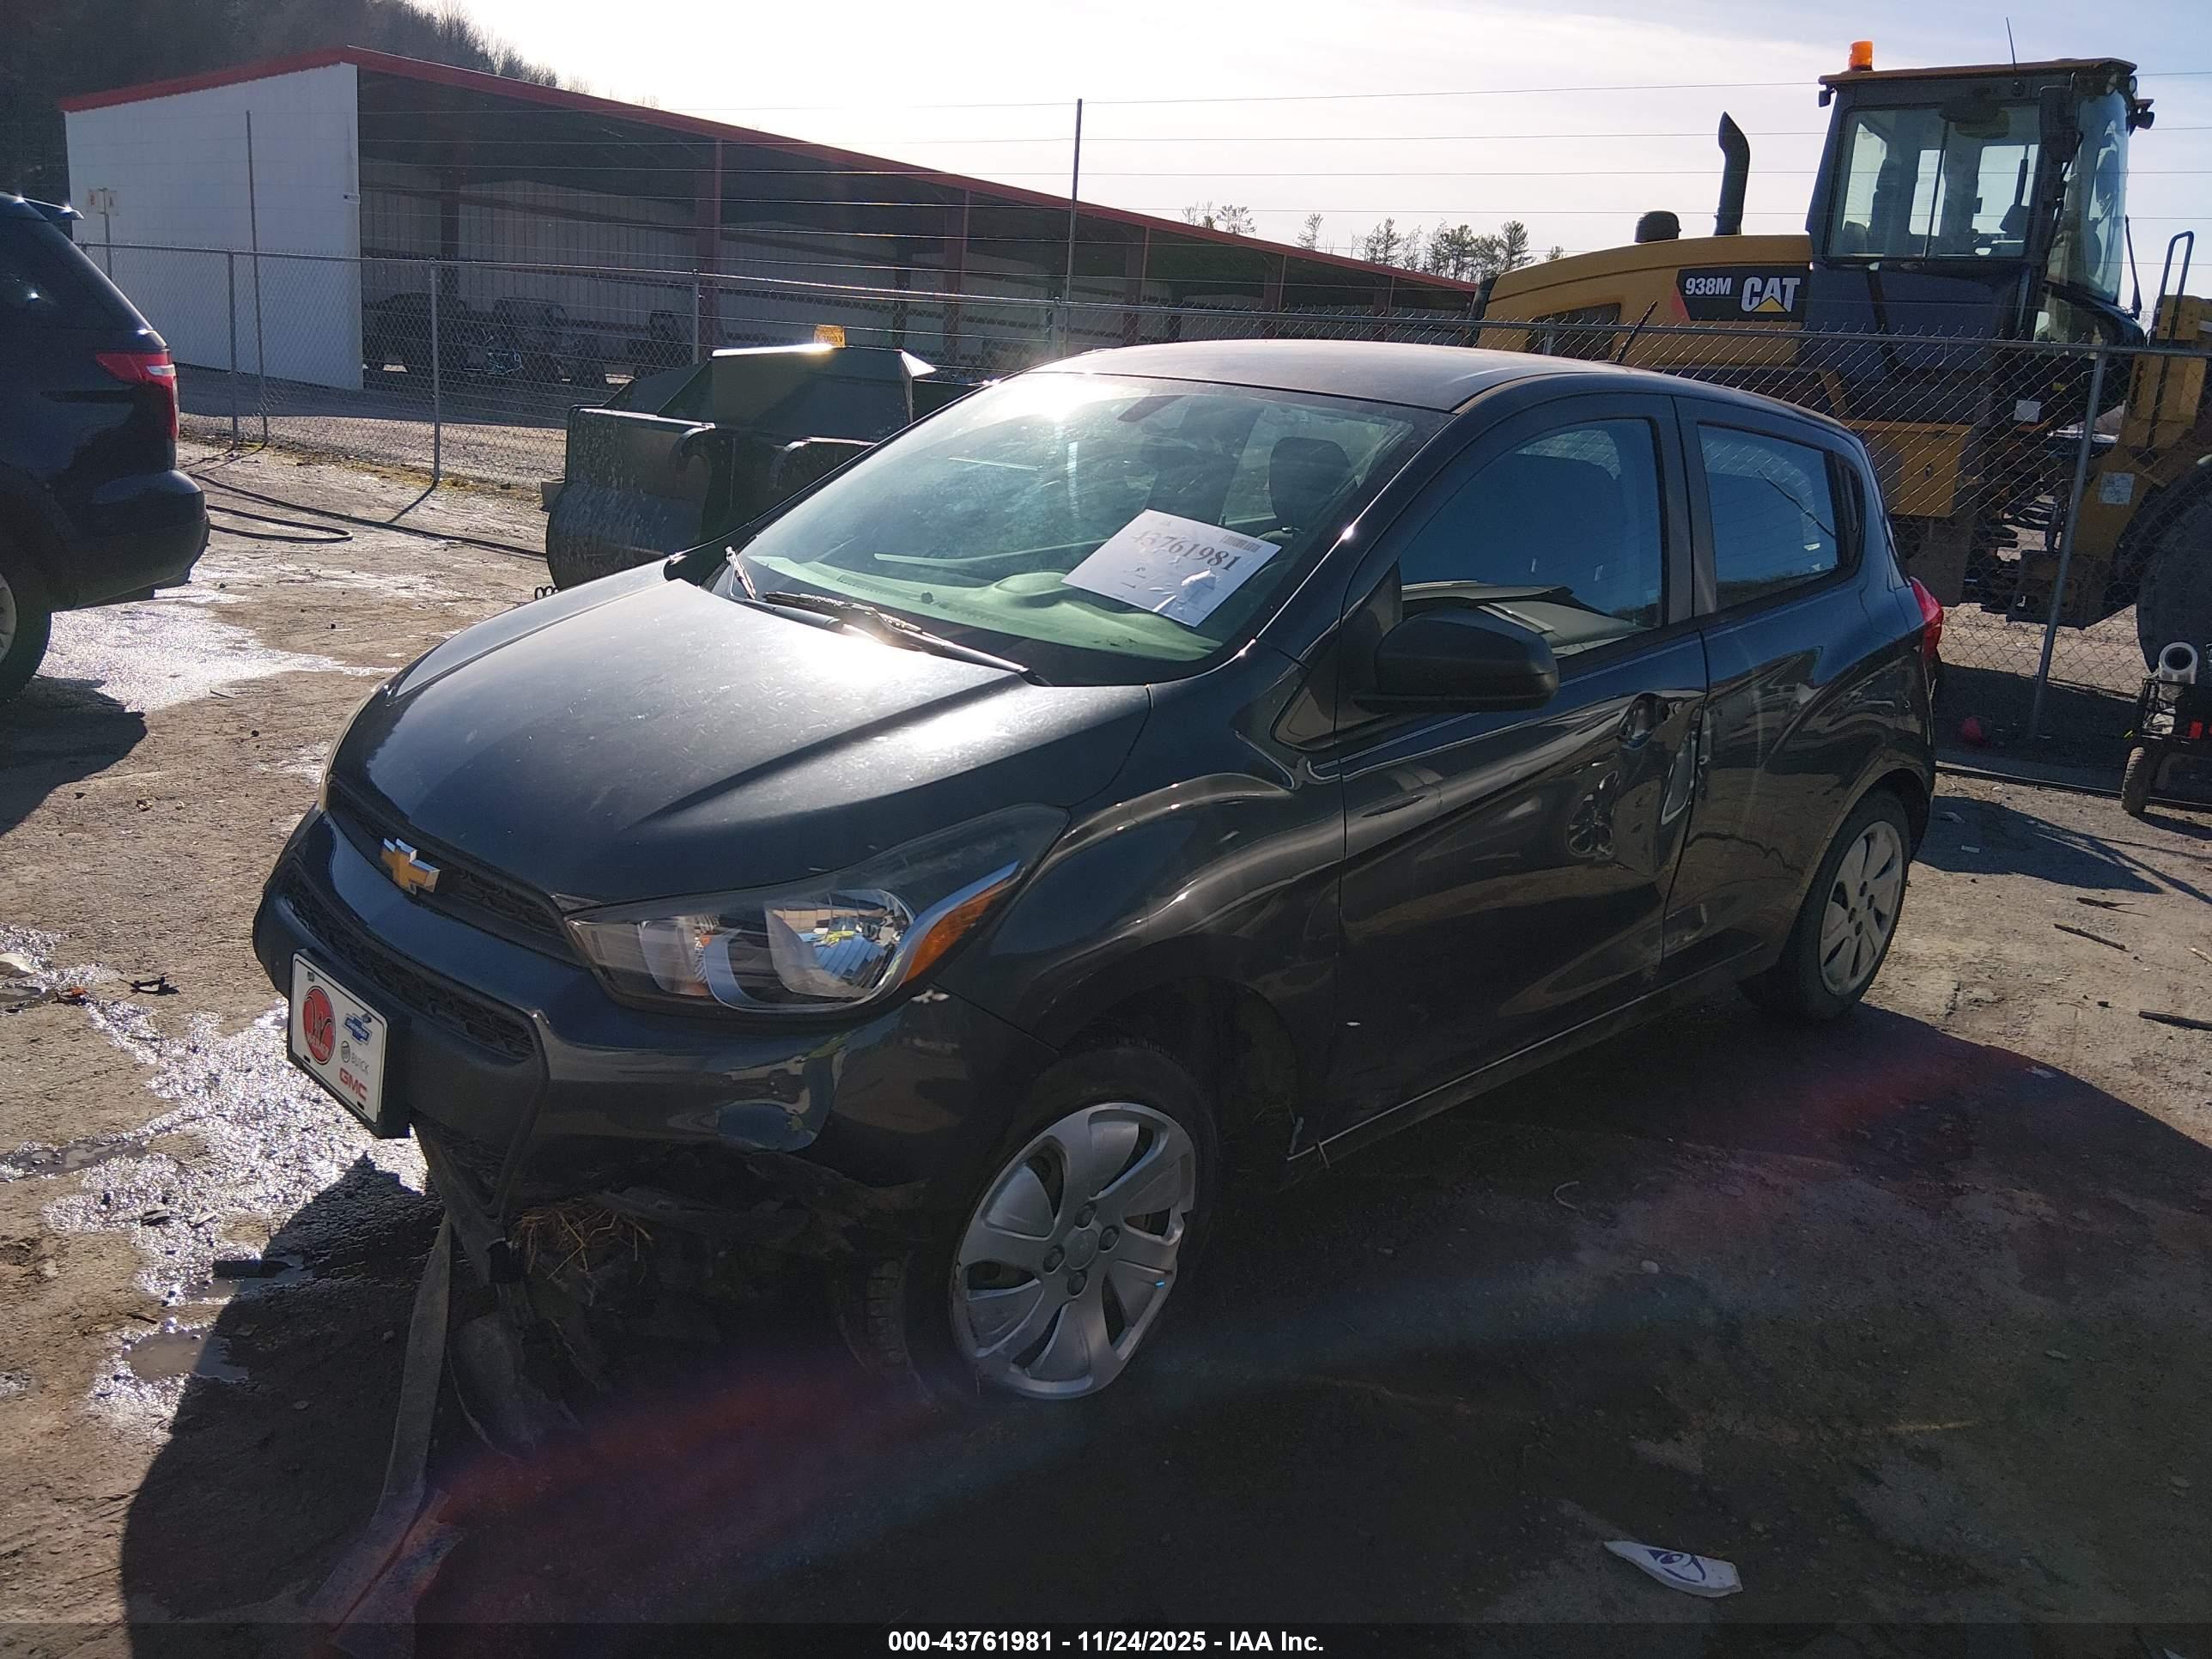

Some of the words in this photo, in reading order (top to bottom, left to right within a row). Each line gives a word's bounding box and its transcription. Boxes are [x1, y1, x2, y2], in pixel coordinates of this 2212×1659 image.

[1685, 277, 1732, 295] 938M
[1741, 276, 1801, 313] CAT
[1131, 529, 1243, 571] 43761981
[351, 1052, 370, 1075] BUICK
[339, 1067, 368, 1102] GMC
